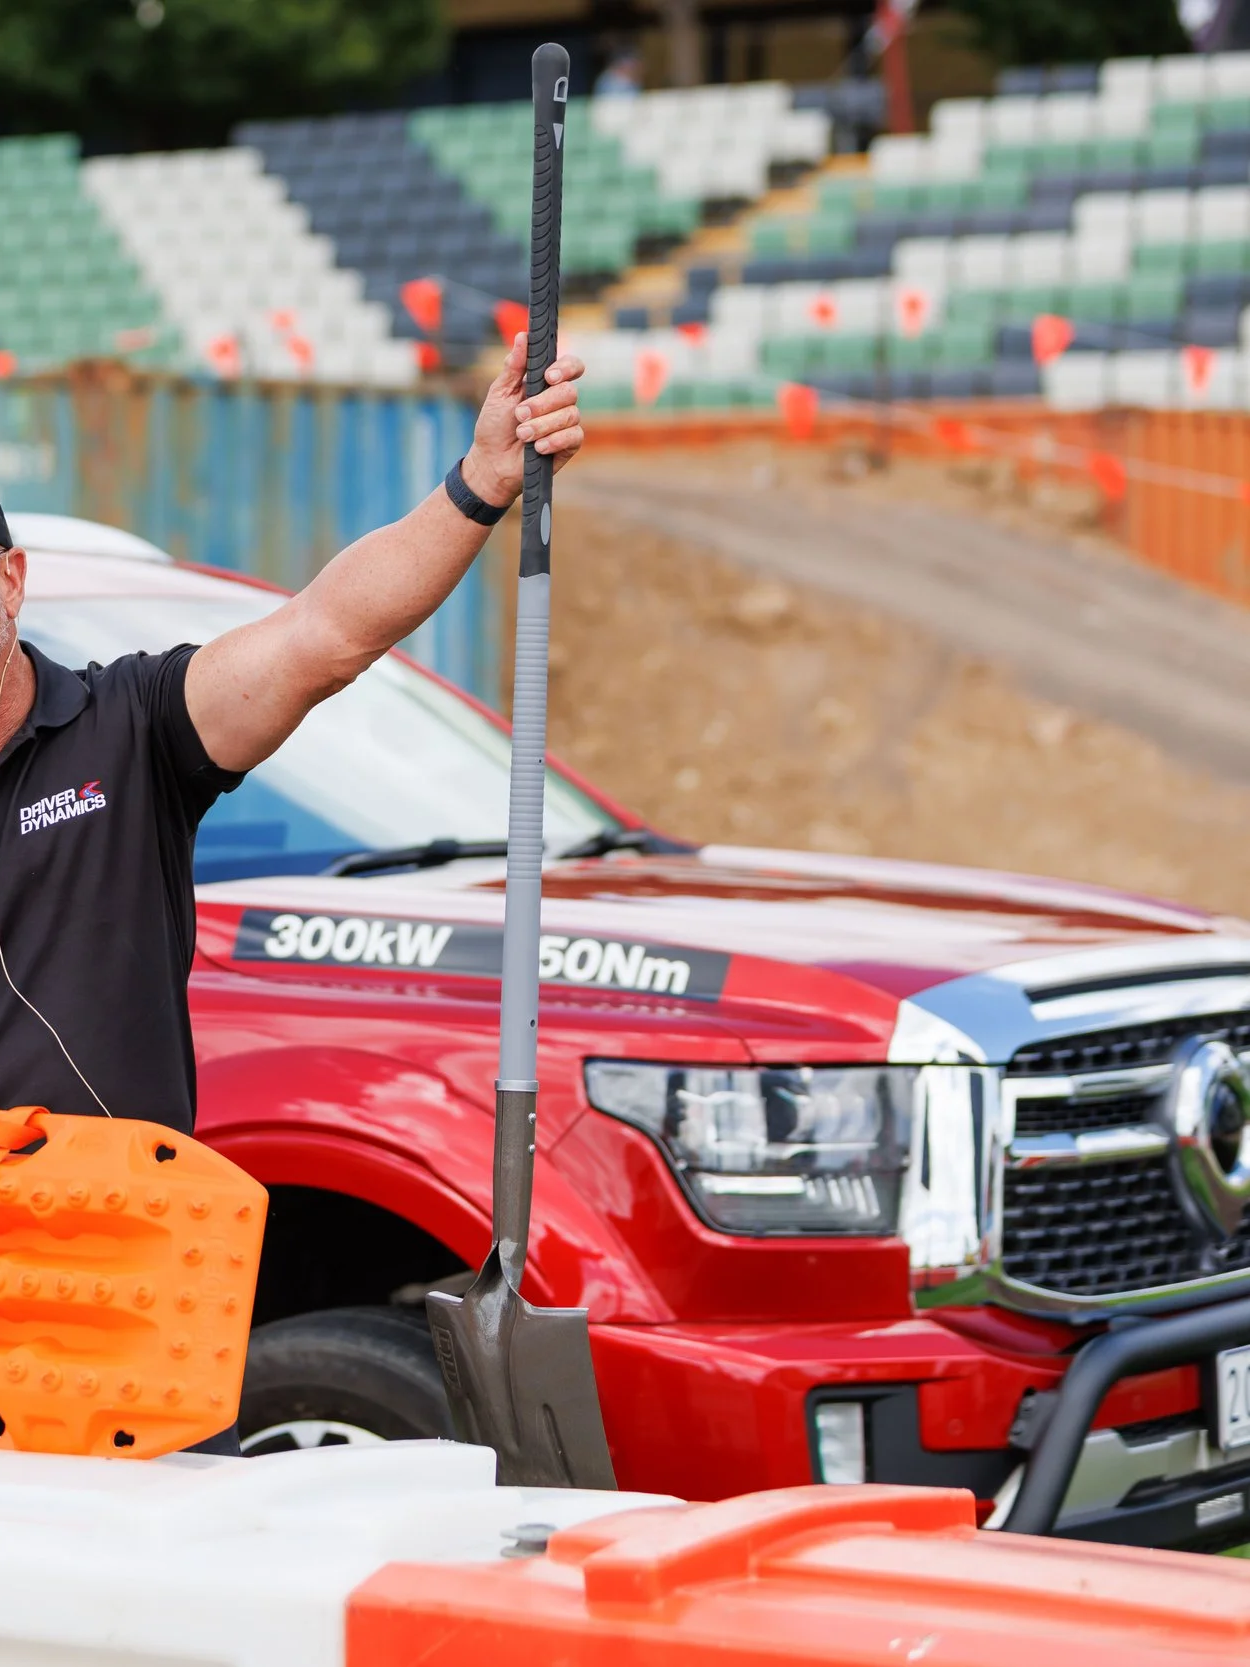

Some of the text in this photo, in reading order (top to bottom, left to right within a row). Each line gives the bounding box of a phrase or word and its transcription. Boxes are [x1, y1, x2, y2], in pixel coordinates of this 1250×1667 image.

[20, 788, 76, 821] DRIVER
[20, 793, 107, 835] DYNAMICS
[264, 913, 453, 968] 300kW
[538, 934, 691, 995] 50Nm
